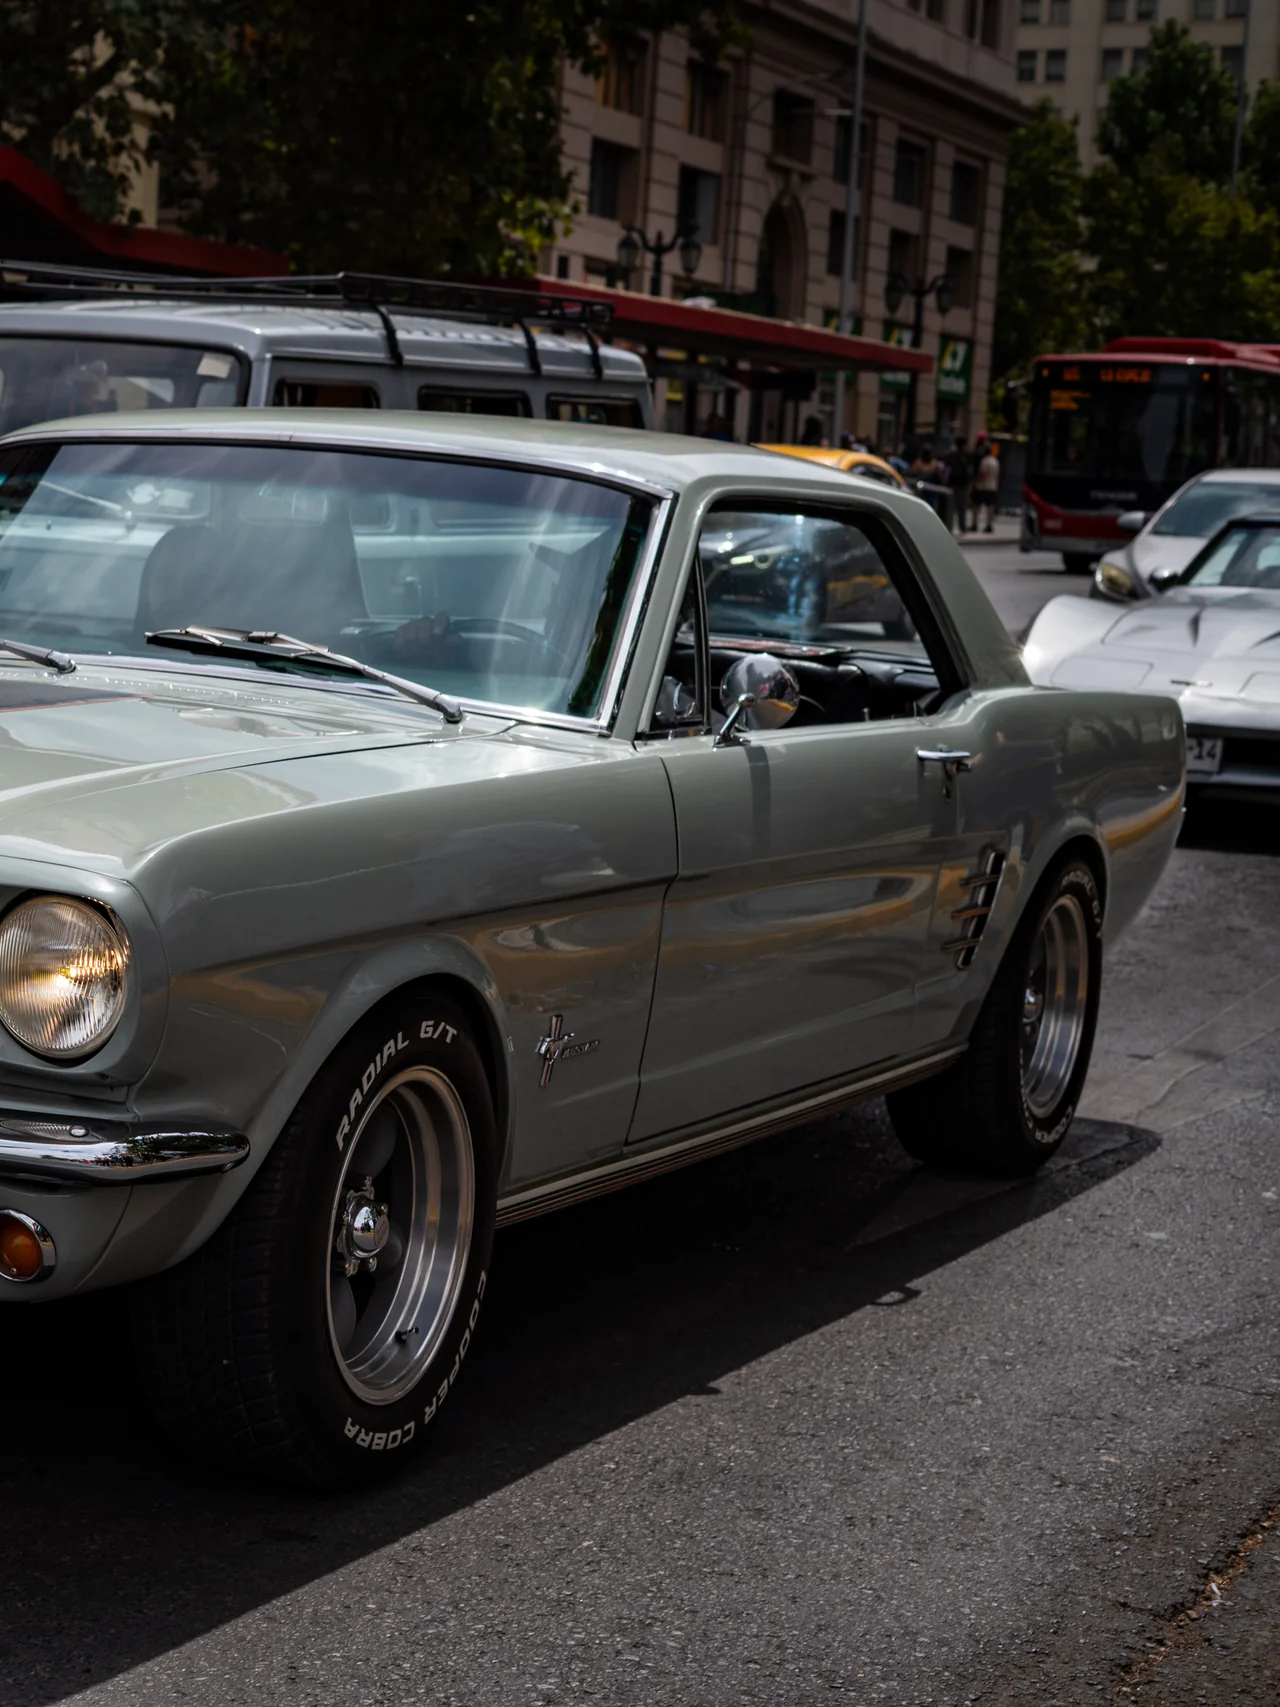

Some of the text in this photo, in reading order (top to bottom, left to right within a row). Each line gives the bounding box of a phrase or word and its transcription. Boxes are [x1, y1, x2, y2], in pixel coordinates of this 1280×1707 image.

[335, 1020, 458, 1152] RADIAL G/T
[343, 1270, 487, 1451] COOPER COBRA
